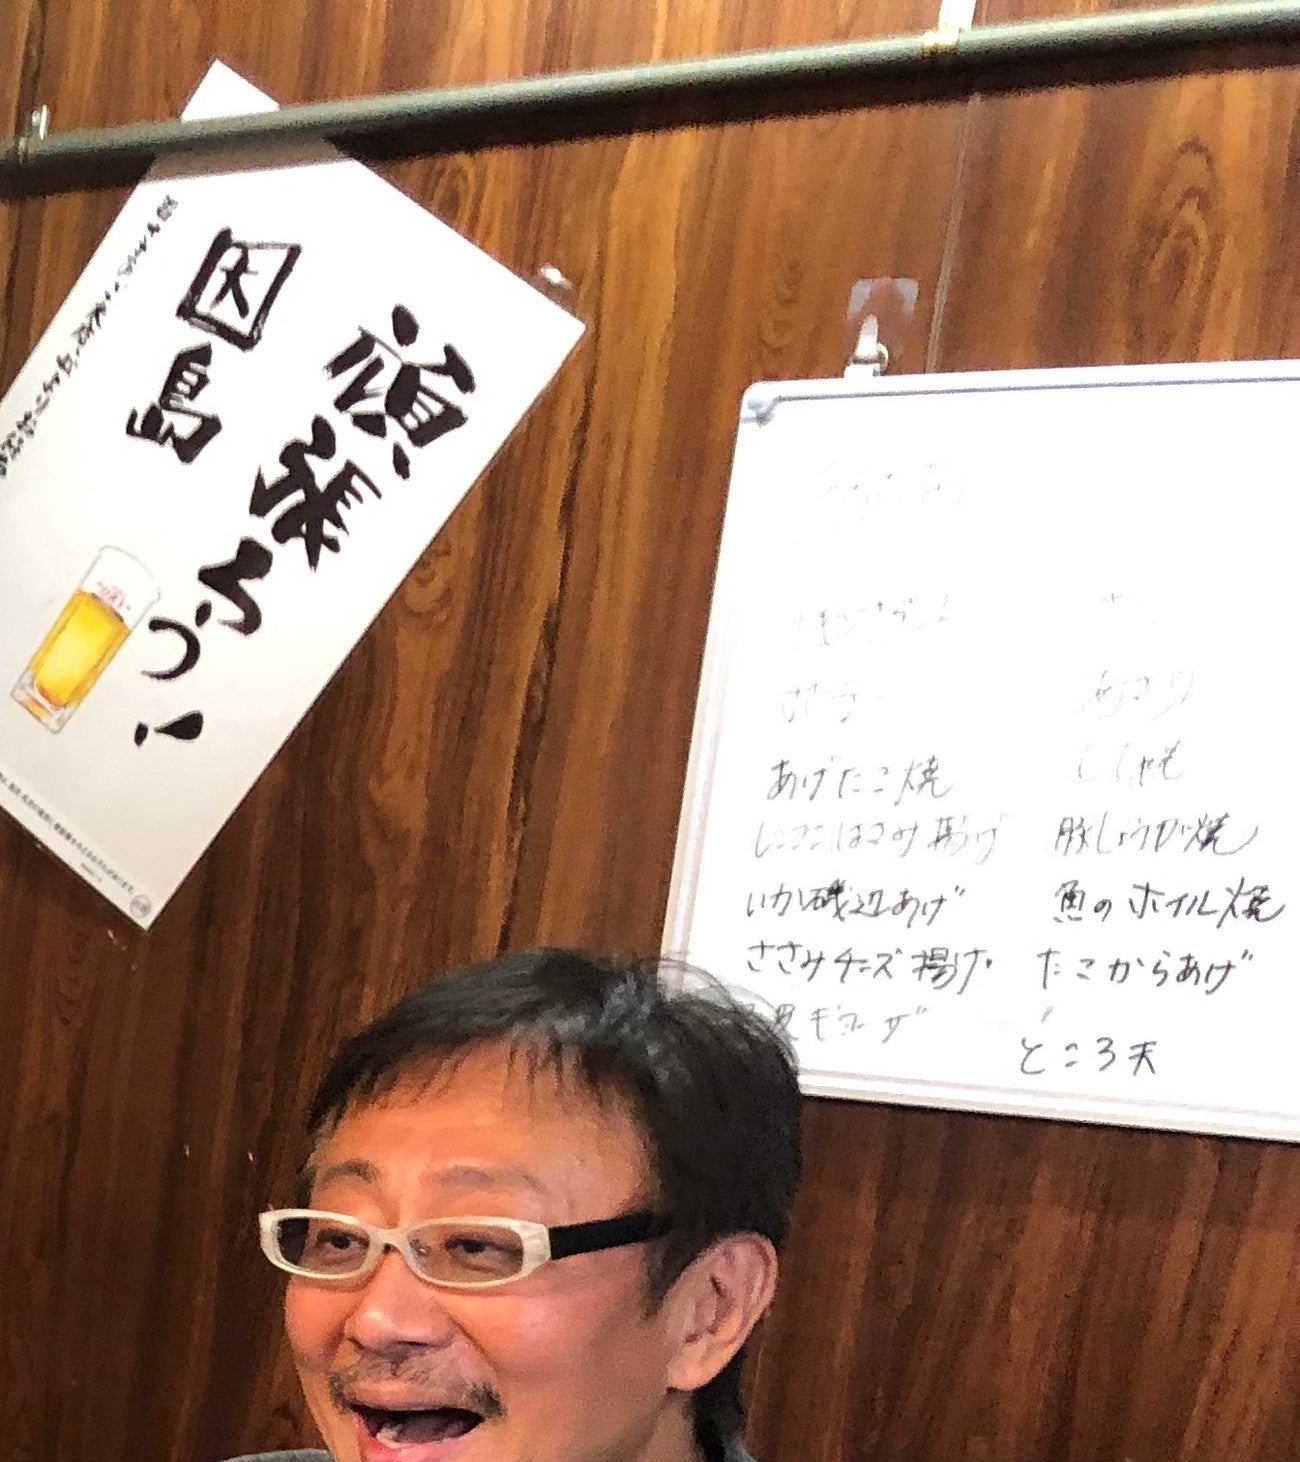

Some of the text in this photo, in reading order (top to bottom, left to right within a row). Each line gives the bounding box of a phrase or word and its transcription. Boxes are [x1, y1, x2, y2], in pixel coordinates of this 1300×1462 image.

[125, 227, 302, 464] 因島
[1053, 876, 1287, 930] 魚のホイル焼
[747, 939, 993, 995] ささみチーズ揚げ
[1036, 947, 1253, 996] たこからあげ
